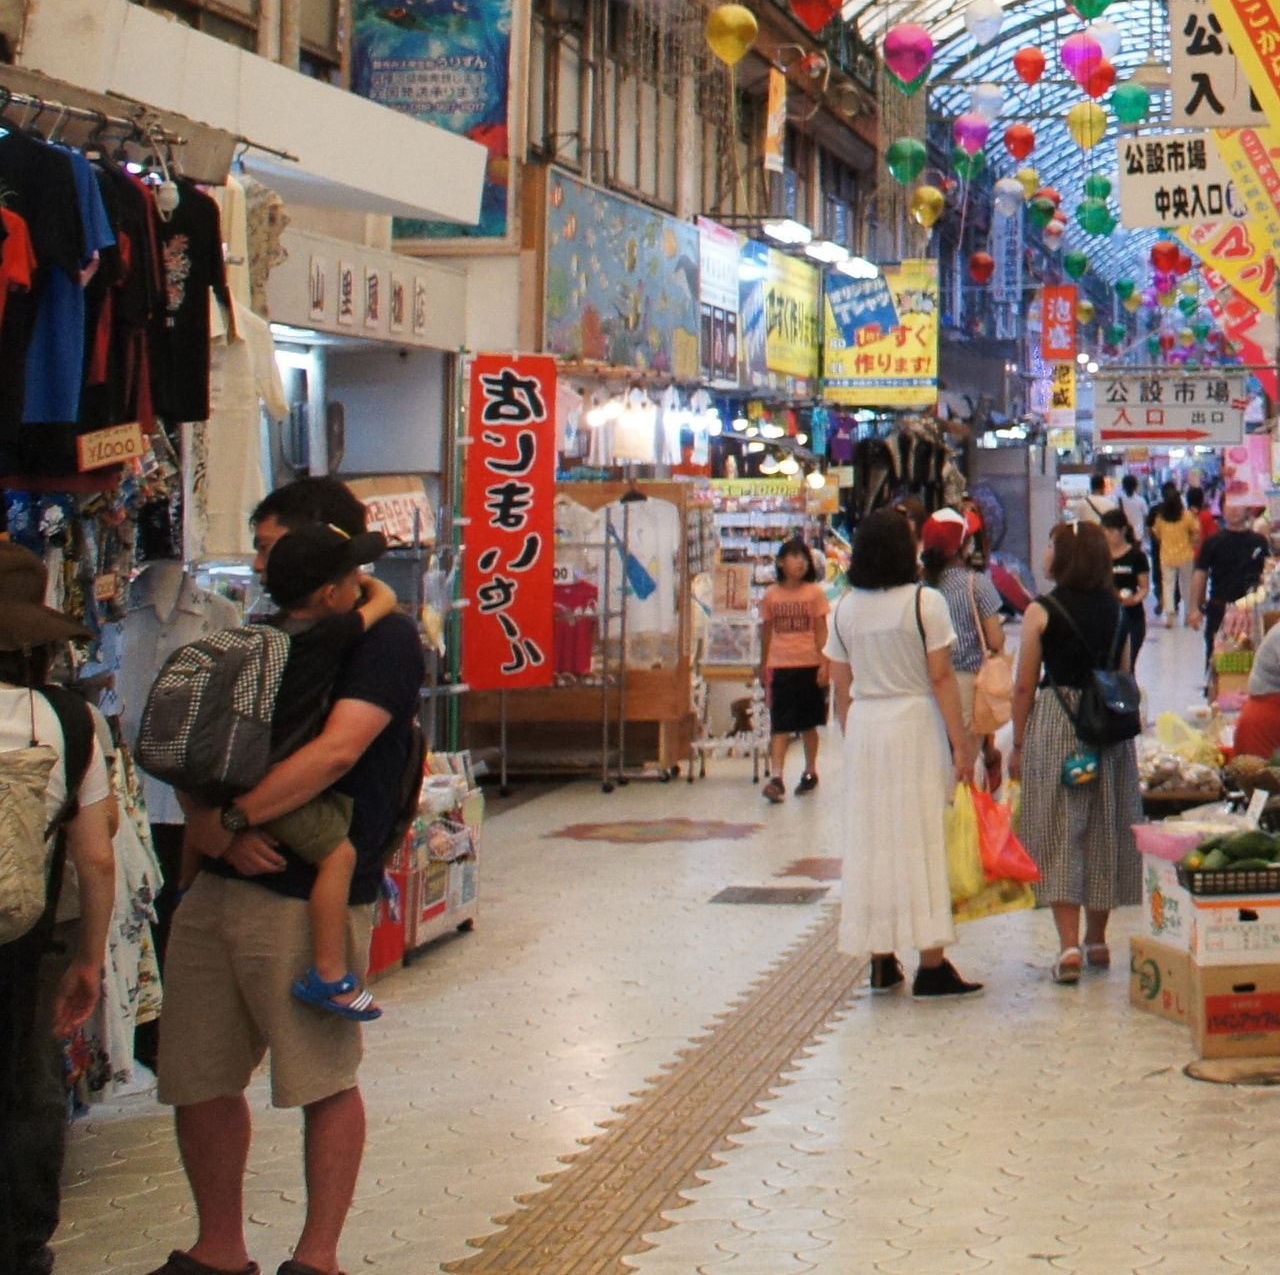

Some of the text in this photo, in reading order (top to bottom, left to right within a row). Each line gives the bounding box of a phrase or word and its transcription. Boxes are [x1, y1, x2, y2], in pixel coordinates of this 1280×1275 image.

[1124, 138, 1207, 175] 公設市場
[1155, 183, 1223, 221] 中央入口
[1106, 379, 1230, 404] 公設市場
[1112, 408, 1225, 426] 入口 出口
